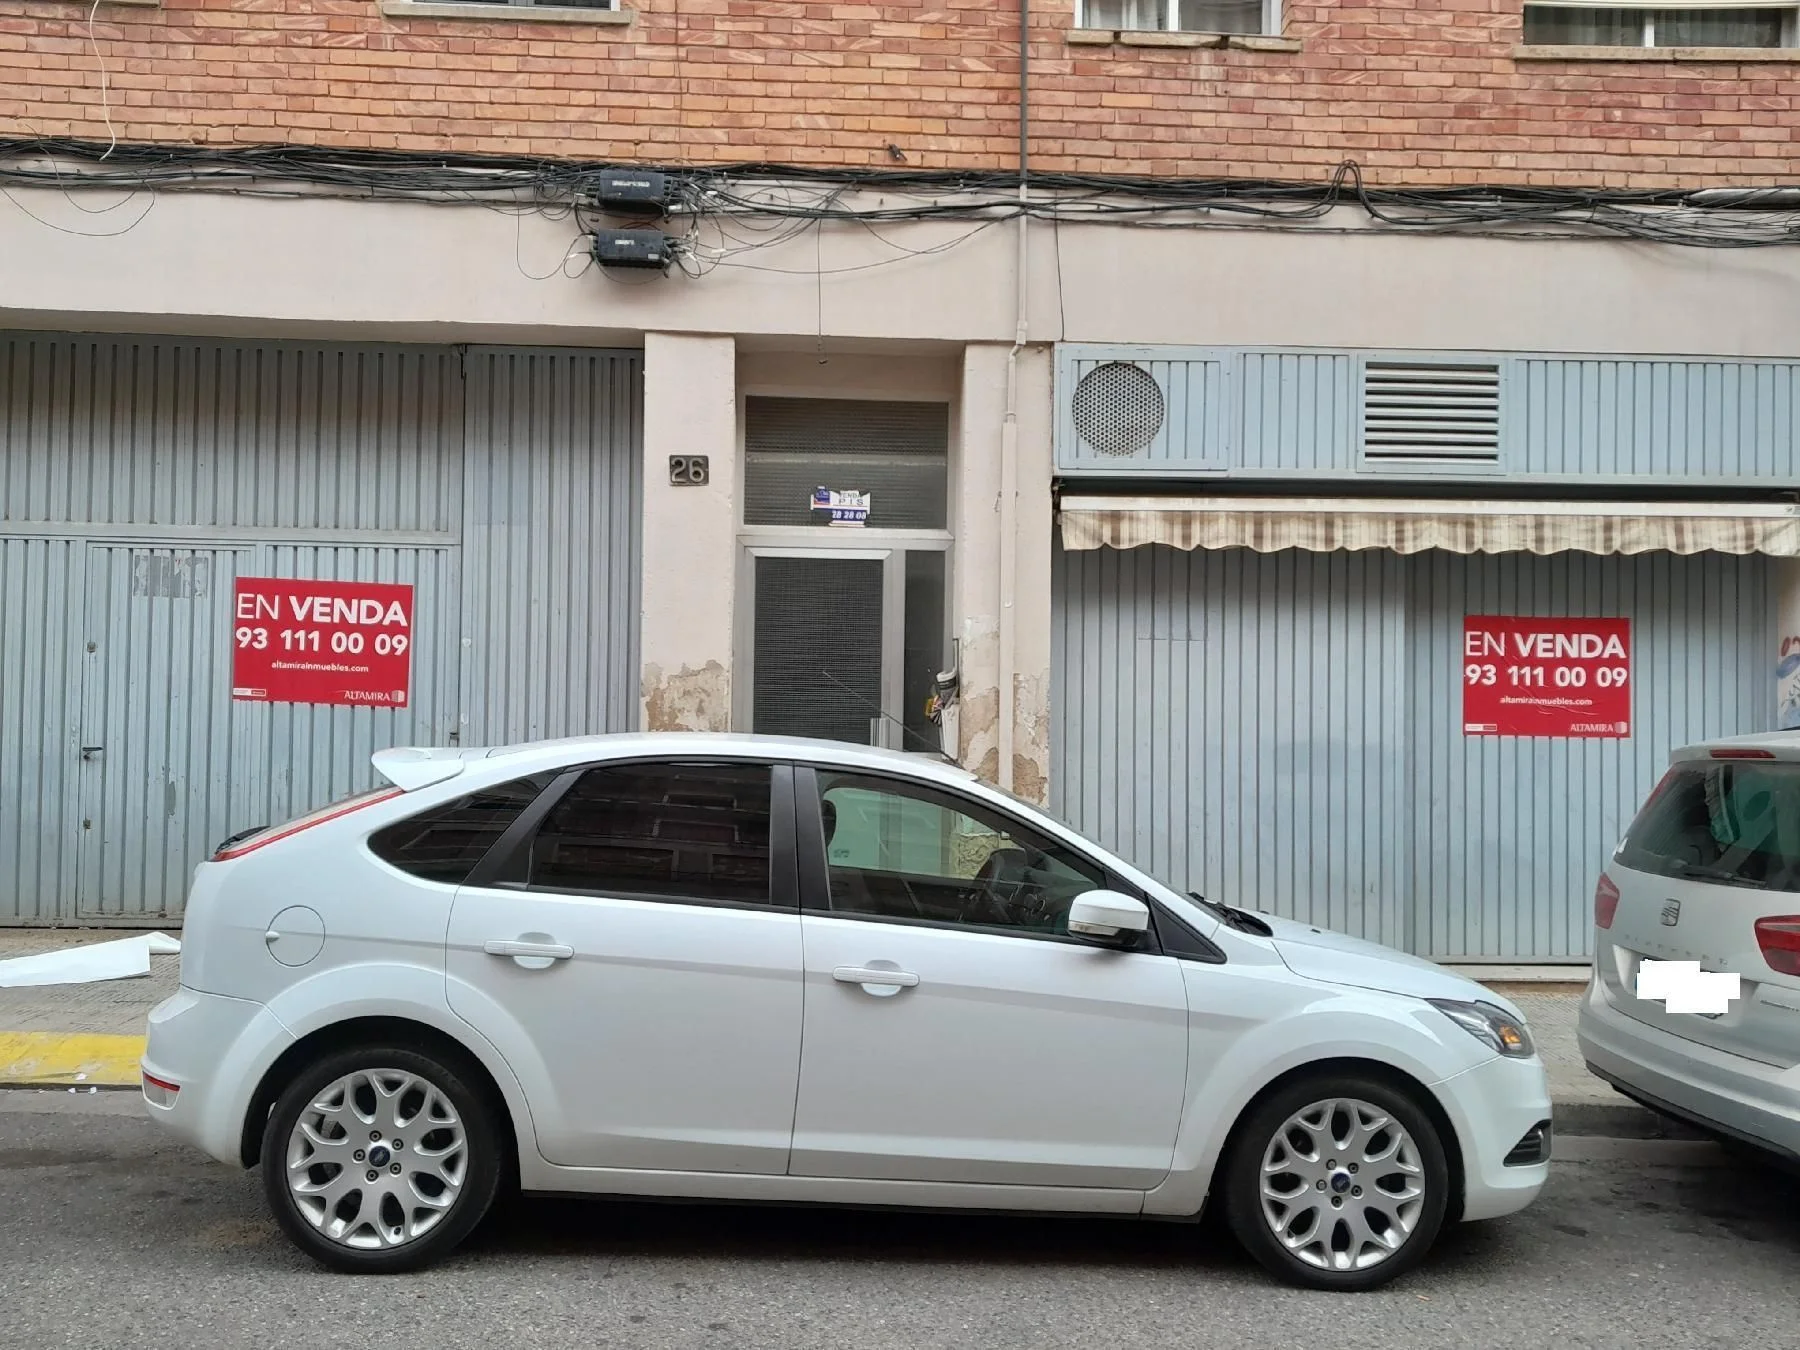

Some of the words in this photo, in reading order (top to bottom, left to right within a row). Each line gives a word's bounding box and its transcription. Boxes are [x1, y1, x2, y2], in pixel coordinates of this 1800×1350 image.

[671, 457, 704, 482] 26
[236, 592, 280, 621] EN
[288, 595, 409, 627] VENDA
[235, 626, 268, 650] 93
[280, 629, 320, 652] 111
[330, 631, 365, 654] 00
[374, 633, 409, 656] 09
[1465, 631, 1506, 657] EN
[1513, 633, 1628, 659] VENDA
[271, 659, 369, 673] altamirainmuebles.com
[1465, 663, 1497, 686] 93
[1507, 665, 1545, 687] 111
[1555, 666, 1587, 687] 00
[1596, 666, 1628, 688] 09
[343, 689, 391, 702] ALTAMIRA
[1500, 694, 1593, 706] altamirainmuebles.com
[1569, 722, 1614, 734] ALTAMIRA
